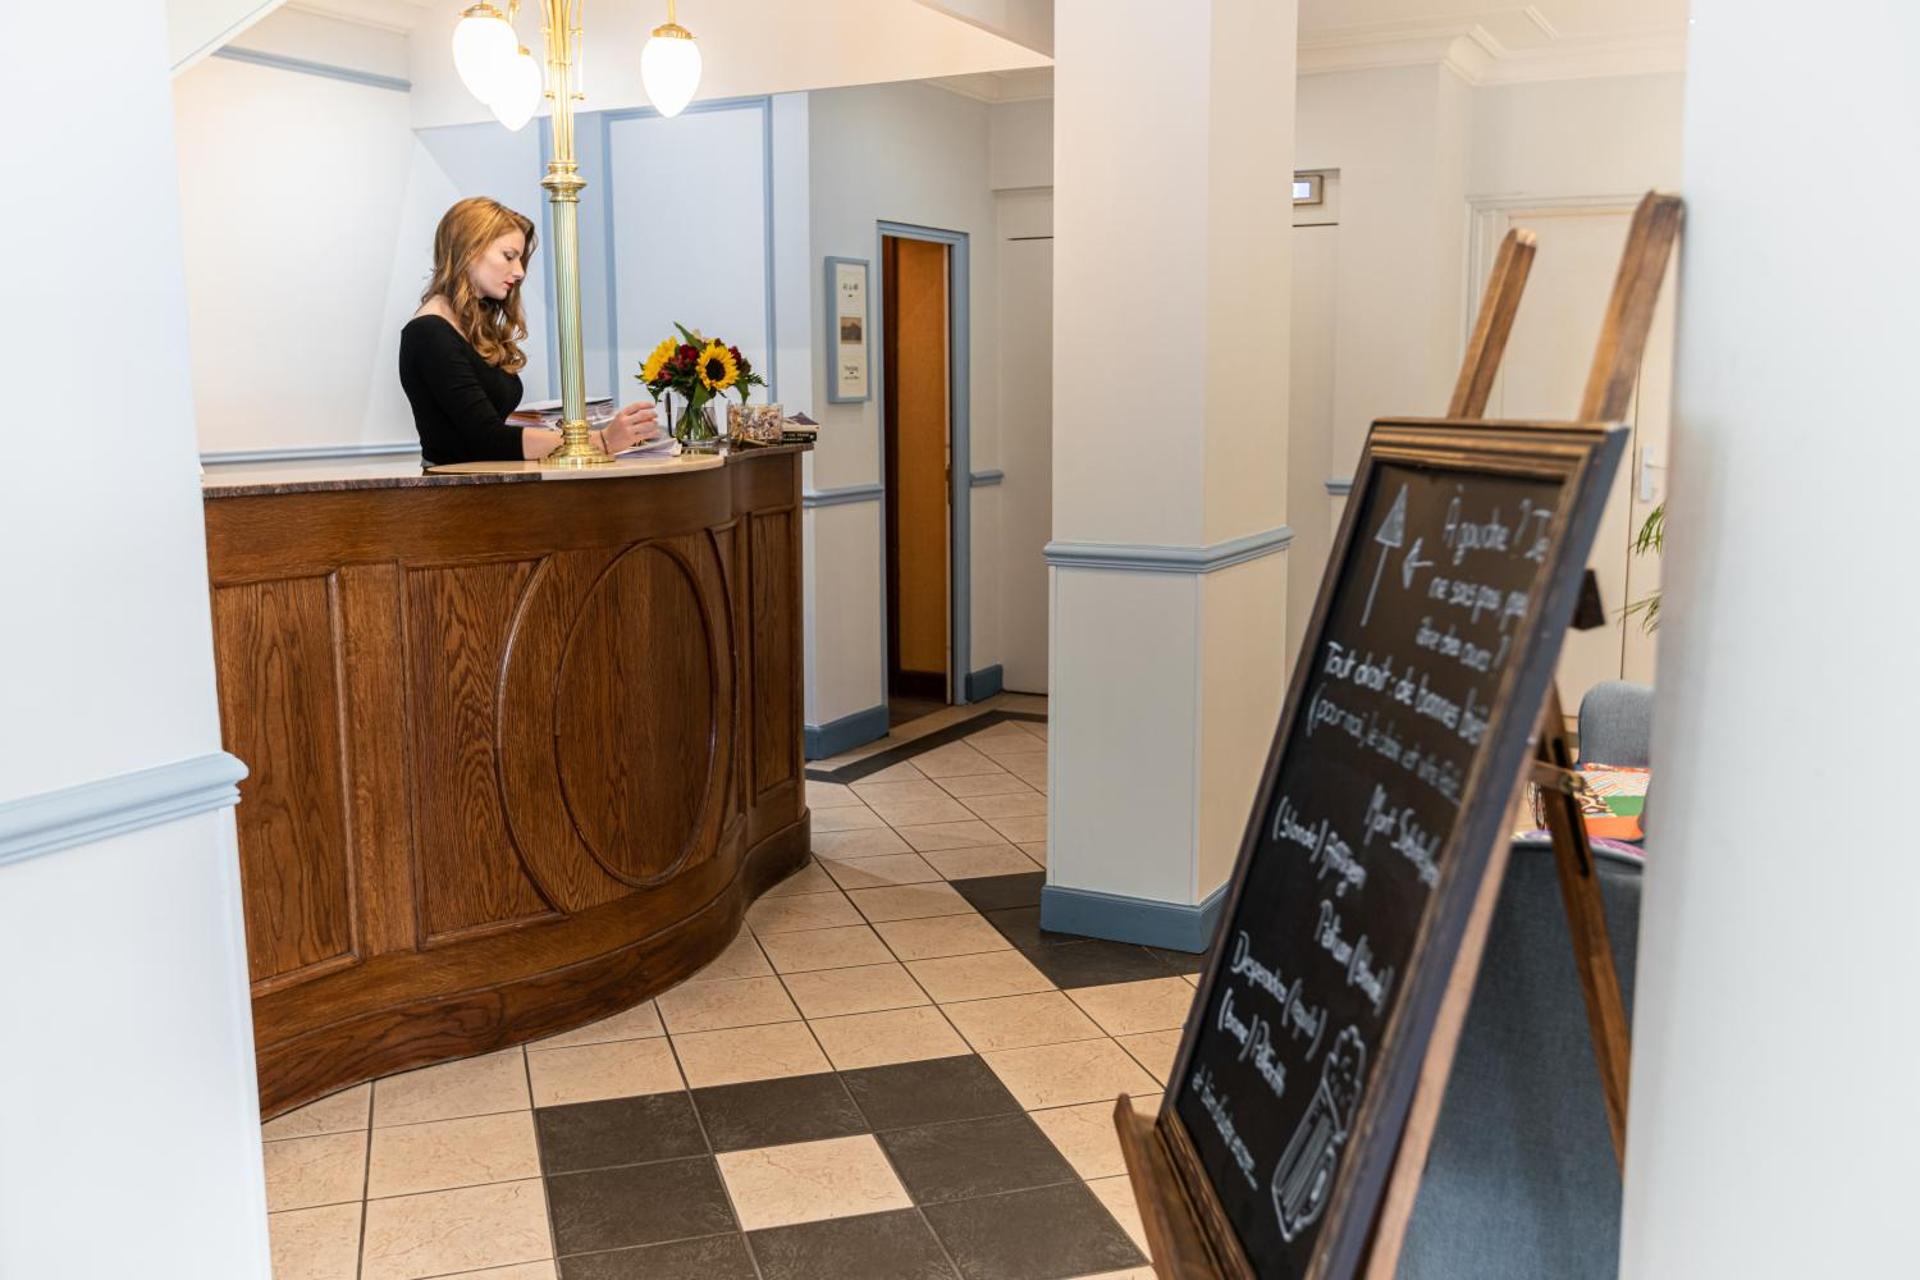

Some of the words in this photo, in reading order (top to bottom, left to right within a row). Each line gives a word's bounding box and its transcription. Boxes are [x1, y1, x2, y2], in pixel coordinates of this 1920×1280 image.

[1306, 683, 1346, 736] (pour
[1324, 641, 1357, 679] Tout
[1354, 653, 1392, 691] droit
[1394, 667, 1416, 705] de
[1415, 674, 1460, 729] bonnes
[1231, 931, 1287, 1003] Desperados
